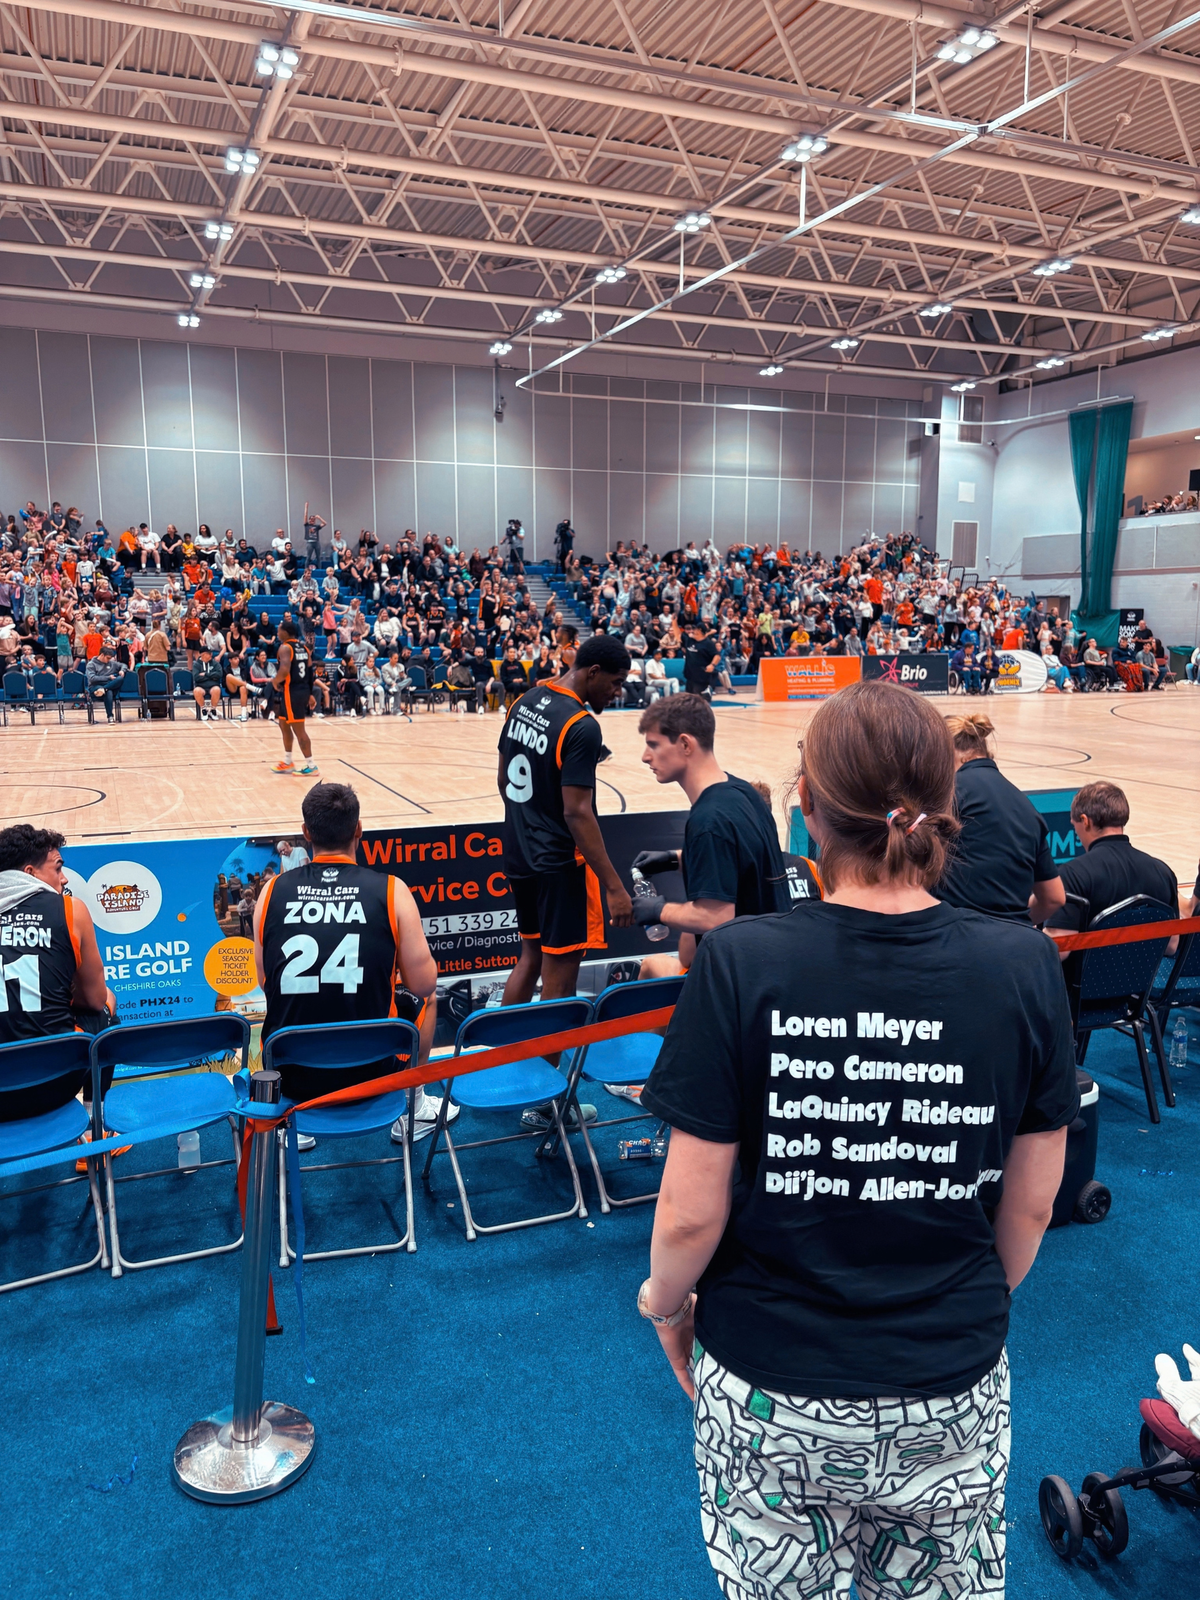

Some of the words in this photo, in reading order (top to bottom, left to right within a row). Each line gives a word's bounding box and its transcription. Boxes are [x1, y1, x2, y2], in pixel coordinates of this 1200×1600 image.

[298, 662, 306, 679] 3
[901, 664, 928, 680] Brio
[537, 715, 550, 727] Cars
[507, 719, 548, 755] LINDO
[506, 754, 533, 803] 9
[362, 834, 457, 866] Wirral
[464, 832, 503, 858] Ca
[297, 885, 332, 896] Wirral
[334, 886, 360, 895] Cars
[486, 872, 513, 898] C
[97, 890, 150, 902] PARADISE
[104, 899, 143, 908] ISLAND
[16, 913, 43, 921] Cars
[284, 901, 367, 924] ZONA
[421, 918, 452, 936] 51
[458, 913, 494, 932] 339
[0, 926, 51, 948] ERON
[465, 931, 523, 948] Diagnosti
[106, 940, 190, 961] ISLAND
[136, 958, 193, 977] GOLF
[280, 933, 364, 995] 24
[437, 959, 472, 973] Little
[475, 955, 518, 969] Sutton
[114, 981, 156, 992] CHESHIRE
[158, 979, 181, 988] OAKS
[140, 996, 180, 1007] PHX24
[771, 1009, 847, 1037] Loren
[856, 1012, 943, 1045] Meyer
[770, 1052, 834, 1080] Pero
[843, 1055, 964, 1084] Cameron
[768, 1091, 892, 1127] LaQuincy
[901, 1098, 995, 1125] Rideau
[767, 1133, 821, 1158] Rob
[831, 1135, 958, 1163] Sandoval
[765, 1169, 850, 1201] Dii'jon
